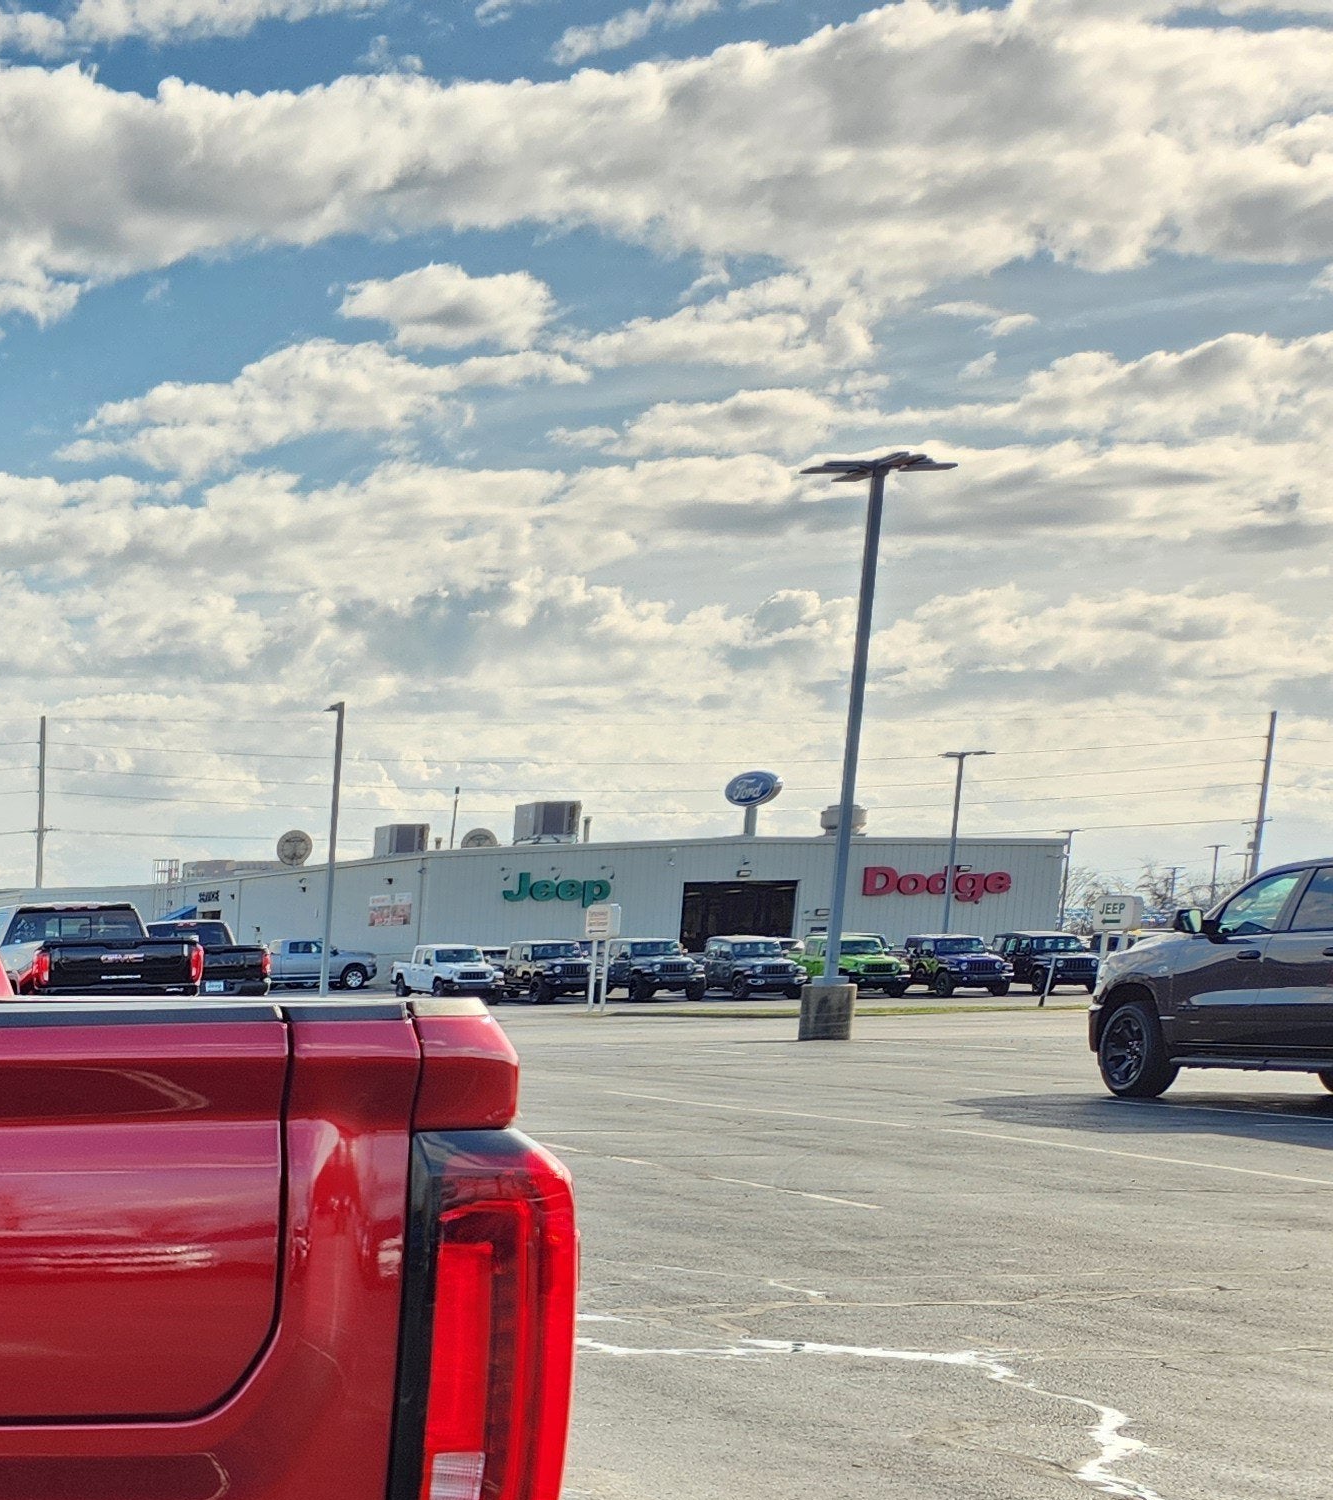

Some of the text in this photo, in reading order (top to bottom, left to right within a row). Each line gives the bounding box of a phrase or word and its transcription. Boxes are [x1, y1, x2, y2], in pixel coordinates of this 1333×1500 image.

[732, 778, 764, 800] Ford
[502, 872, 612, 909] Jeep
[862, 865, 1012, 905] Dodge
[1099, 902, 1126, 915] JEEP
